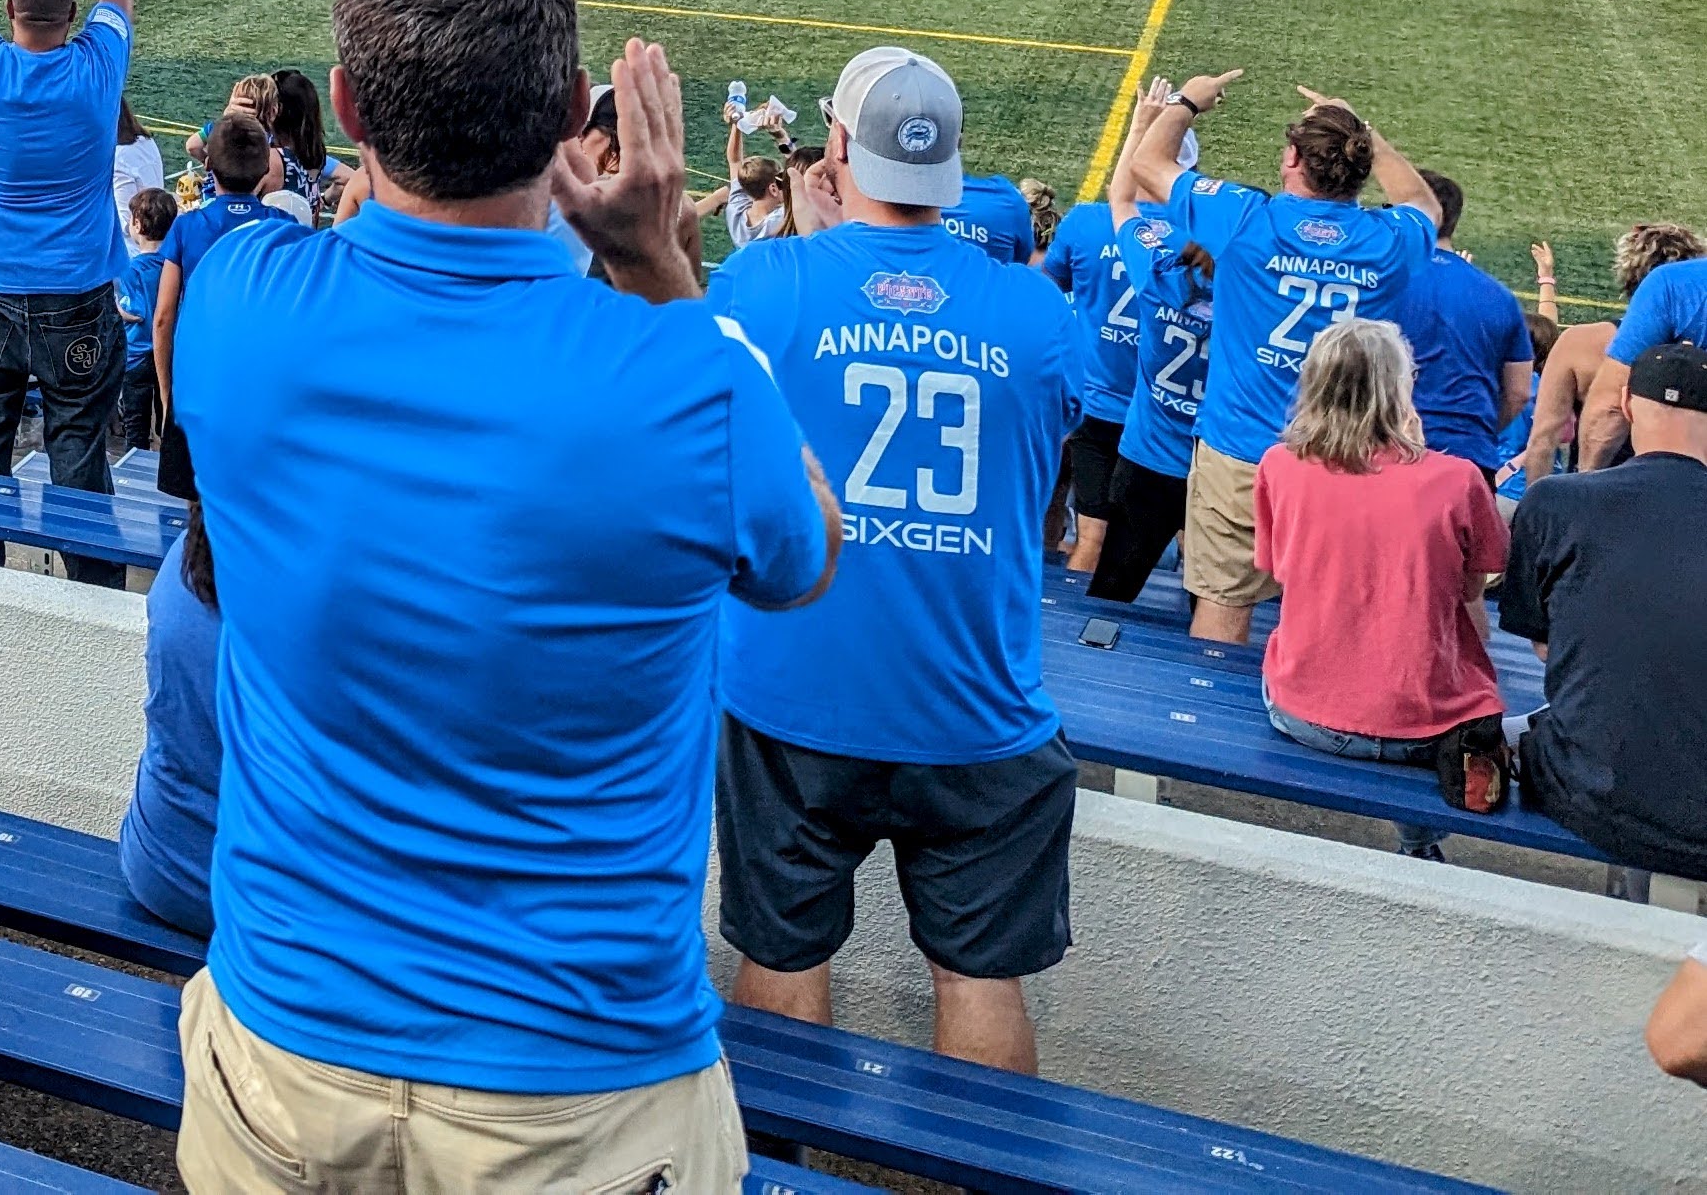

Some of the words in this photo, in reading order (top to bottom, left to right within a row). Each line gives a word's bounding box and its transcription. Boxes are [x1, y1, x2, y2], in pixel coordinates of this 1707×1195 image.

[1264, 255, 1379, 289] ANNAPOLIS
[813, 322, 1011, 378] ANNAPOLIS
[1150, 384, 1199, 416] SIXG
[844, 362, 981, 515] 23
[840, 513, 993, 556] SIXGEN
